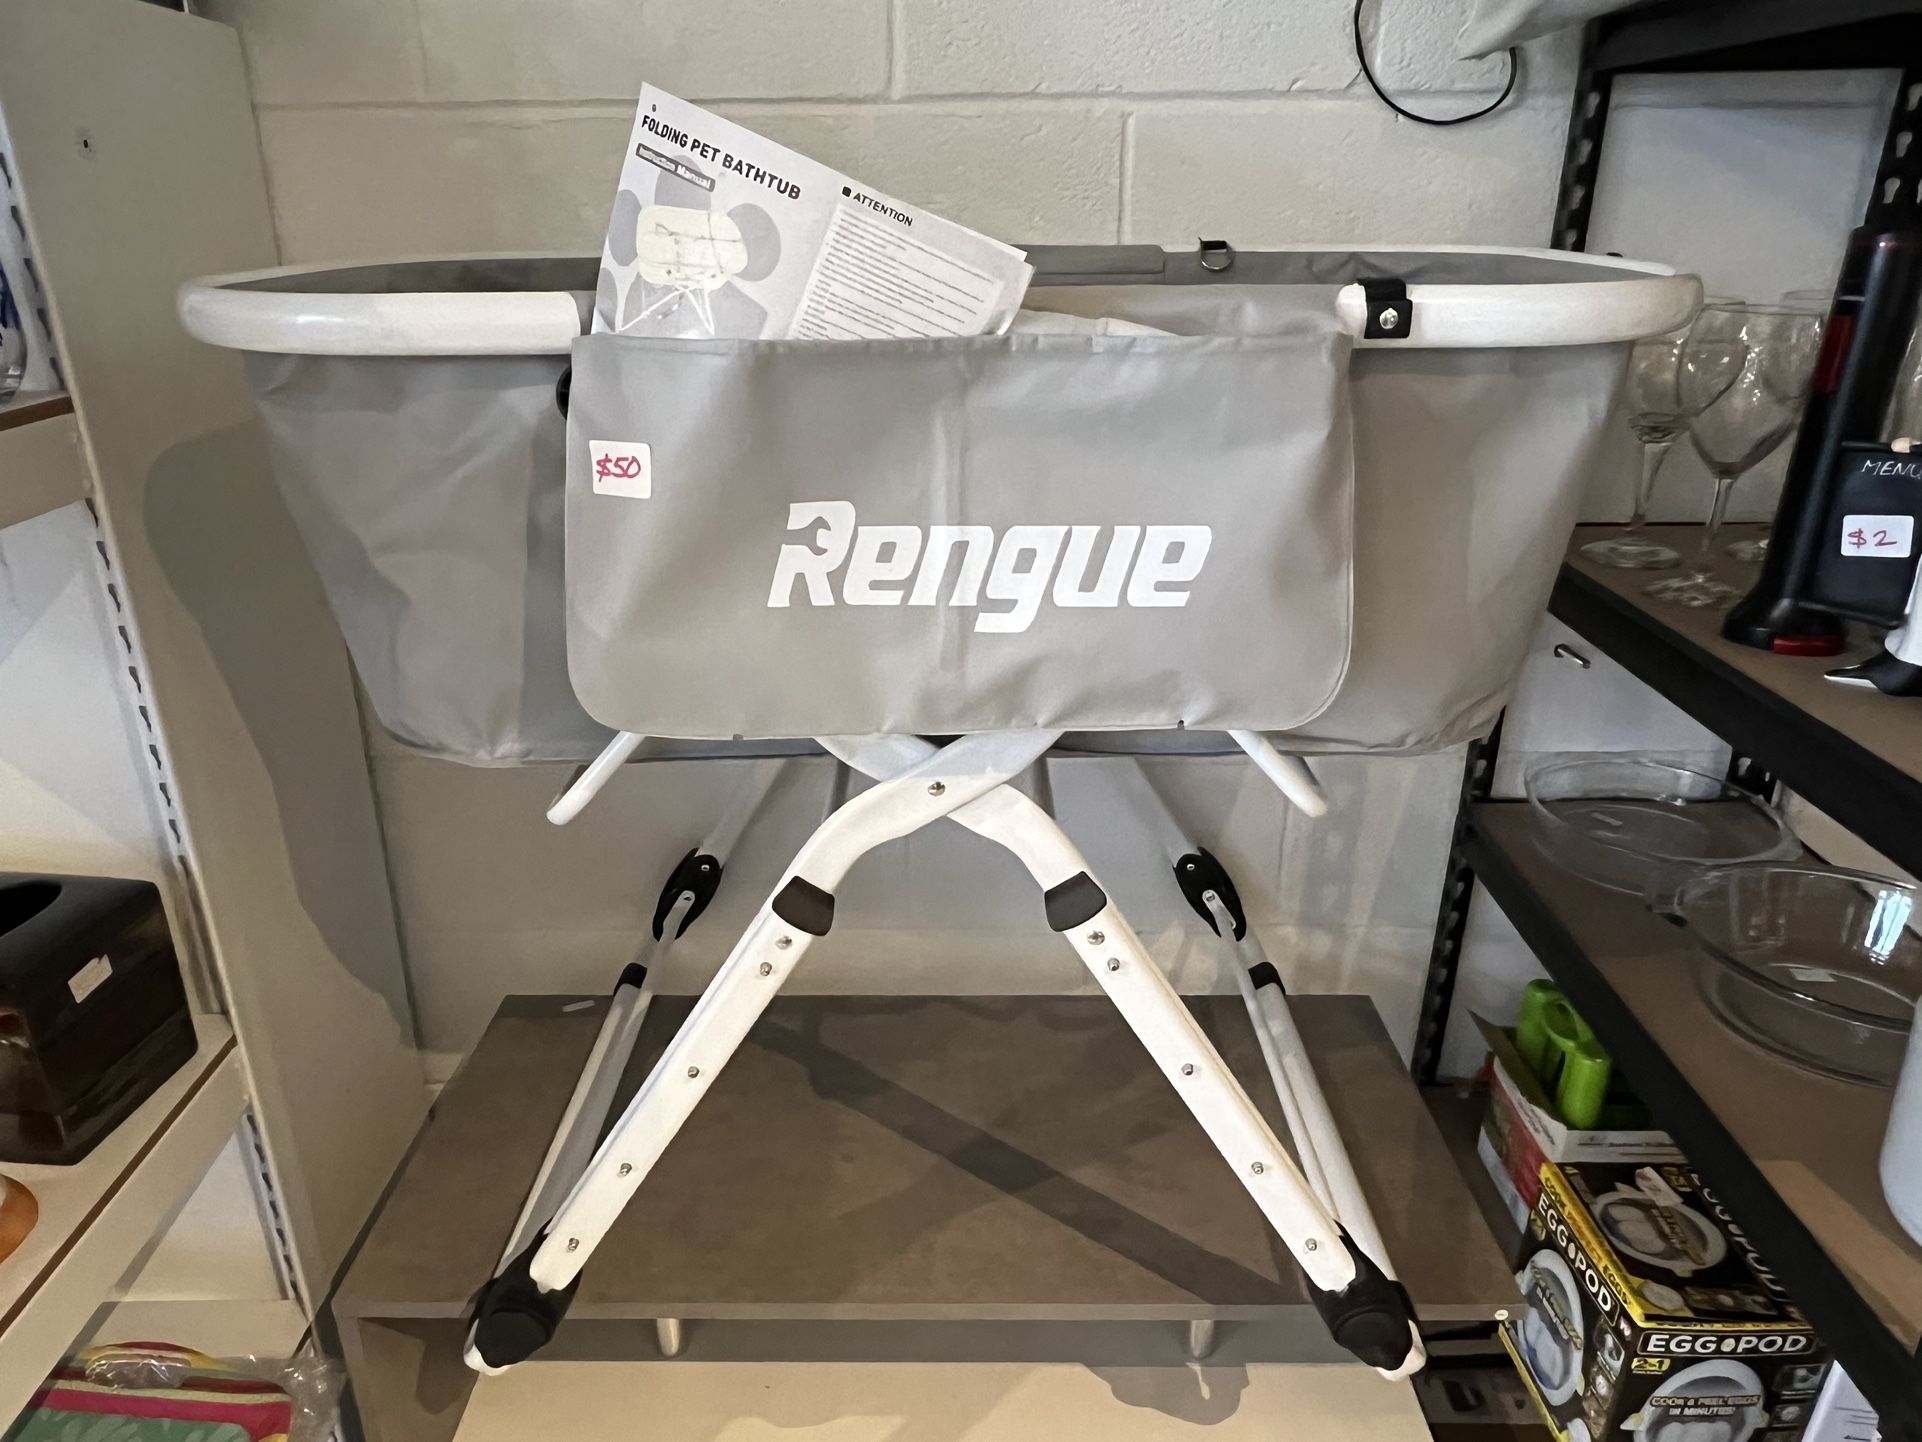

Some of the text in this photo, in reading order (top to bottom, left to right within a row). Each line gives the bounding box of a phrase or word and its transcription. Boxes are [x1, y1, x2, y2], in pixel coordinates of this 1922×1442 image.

[641, 114, 802, 200] FOLDING PET BATHTUB
[676, 164, 712, 190] Manual
[853, 192, 913, 227] ATTENTION
[595, 453, 642, 484] $50
[766, 500, 1213, 634] Rengue
[1538, 1193, 1568, 1246] EGG
[1575, 1250, 1612, 1312] POD
[1647, 1334, 1807, 1354] EGG POD
